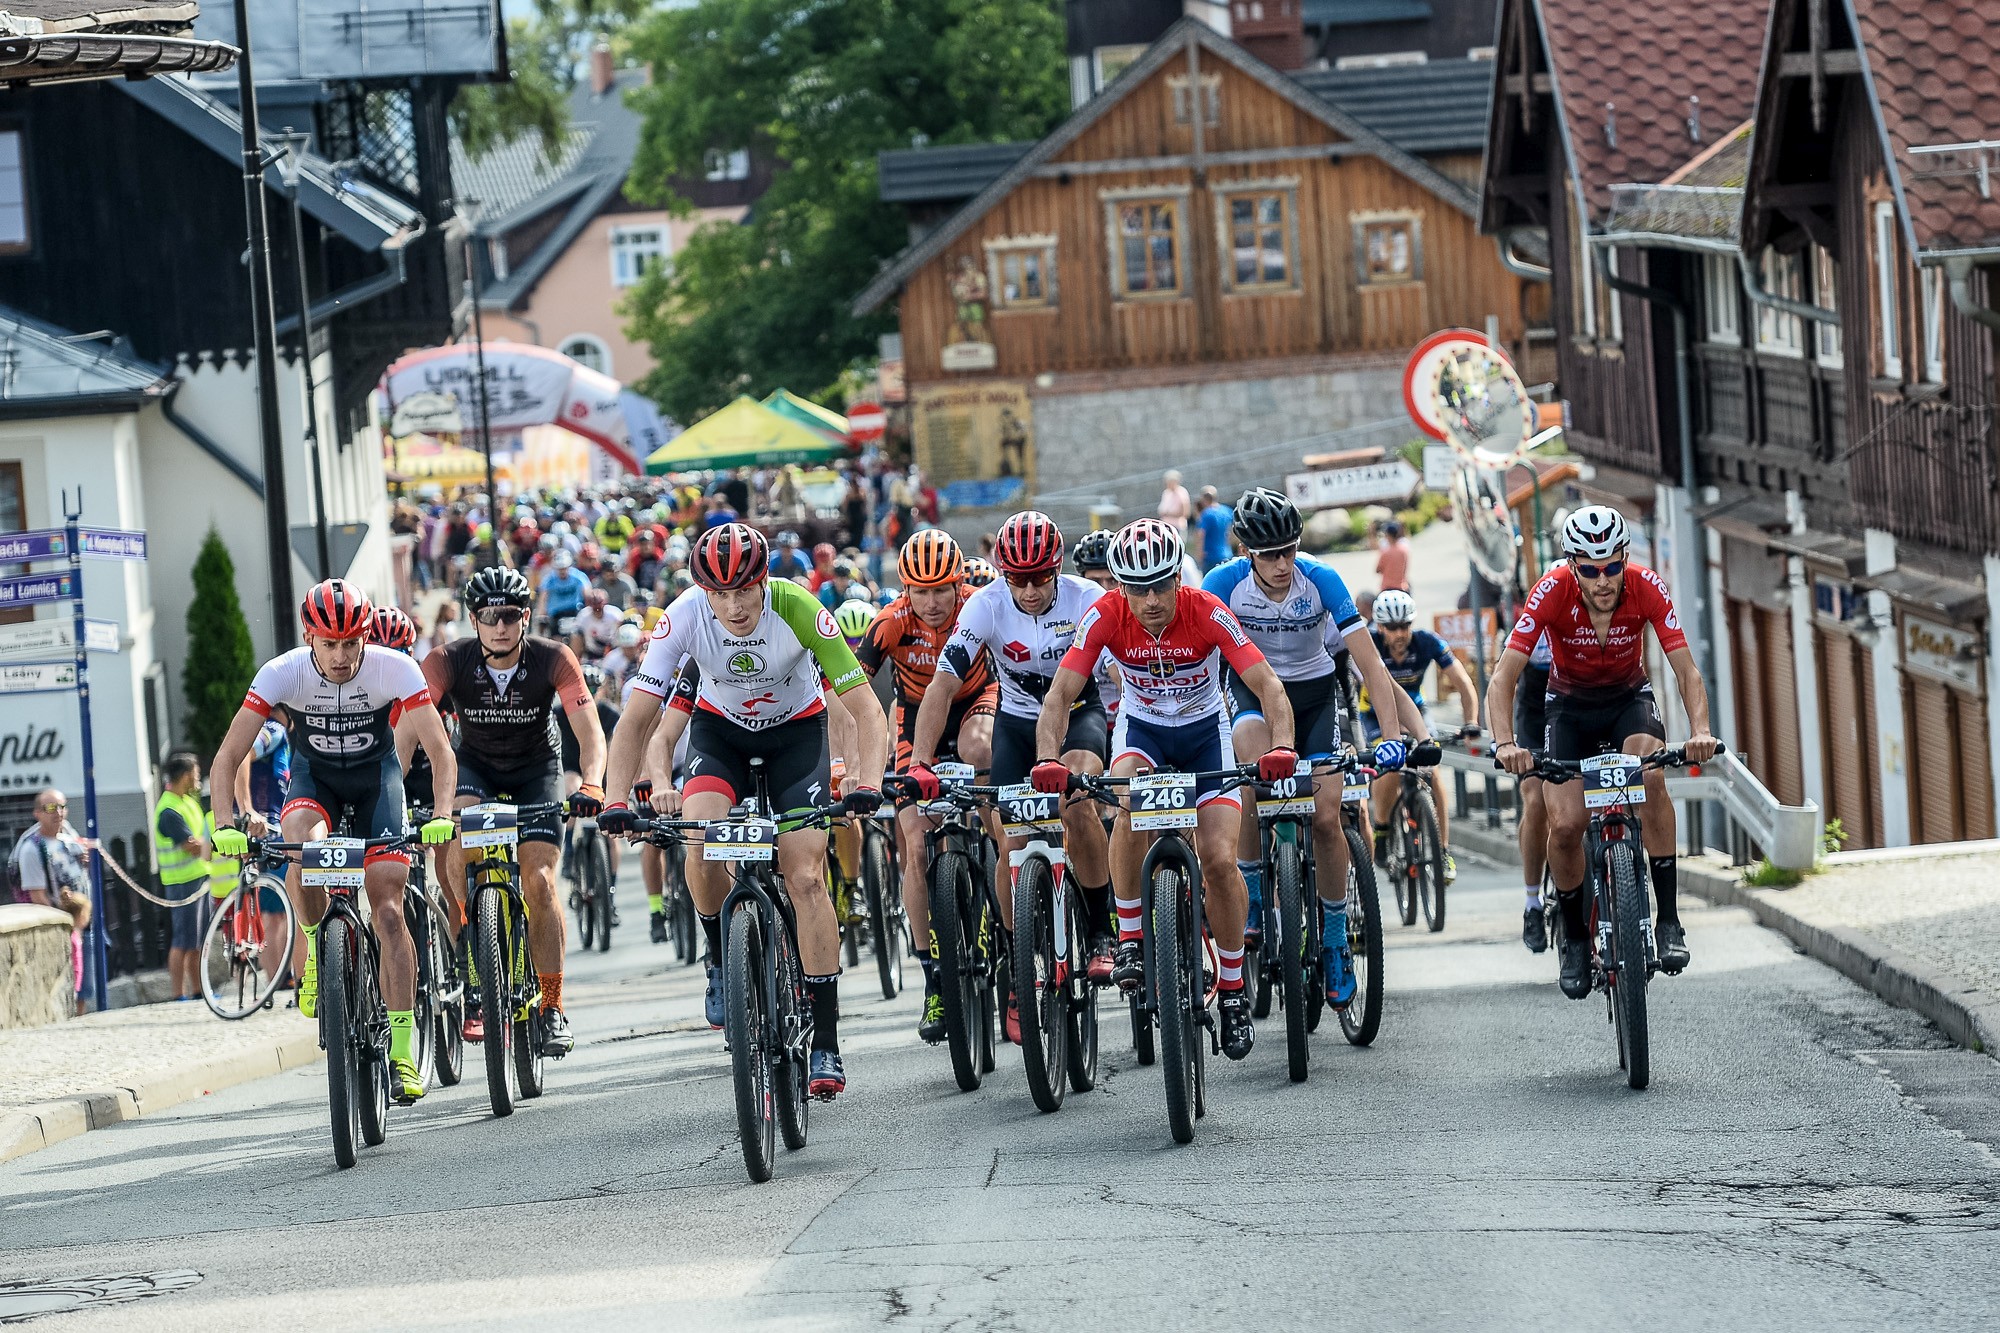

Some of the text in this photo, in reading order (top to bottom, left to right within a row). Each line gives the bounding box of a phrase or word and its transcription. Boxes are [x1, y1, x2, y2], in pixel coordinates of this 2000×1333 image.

[1528, 575, 1559, 611] uvex
[1641, 569, 1673, 604] uvex
[1043, 619, 1073, 629] UPHILL
[1267, 624, 1299, 633] RACING
[723, 637, 767, 647] ŠKODA
[960, 628, 982, 645] dpd
[329, 717, 374, 732] Bertrand
[722, 705, 794, 731] IMMOTION
[1600, 768, 1627, 788] 58
[1140, 788, 1186, 810] 246
[1008, 798, 1050, 821] 304
[482, 813, 495, 829] 2
[716, 826, 763, 842] 319
[319, 848, 347, 868] 39
